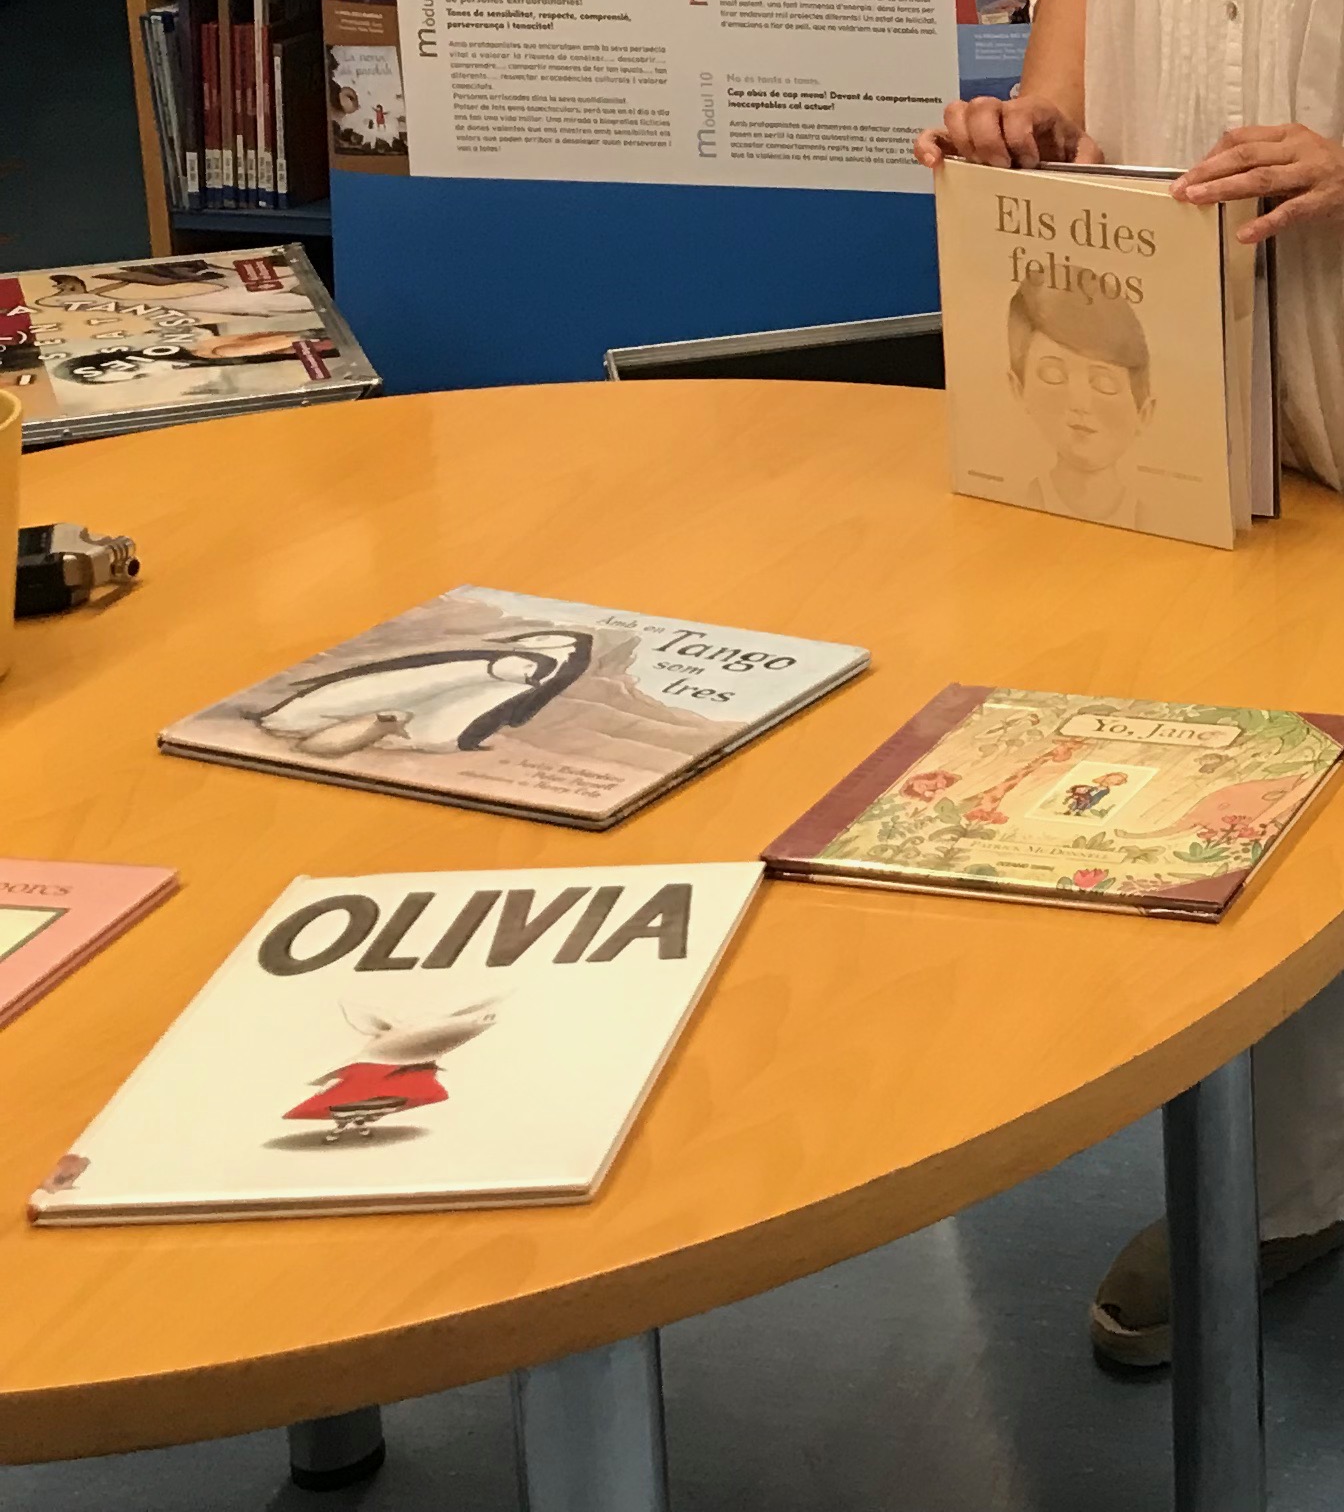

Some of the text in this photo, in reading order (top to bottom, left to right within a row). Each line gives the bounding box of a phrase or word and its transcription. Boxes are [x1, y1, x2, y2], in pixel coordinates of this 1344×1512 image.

[994, 194, 1158, 258] Els dies
[1008, 246, 1145, 306] feliços
[596, 615, 638, 629] Amb
[651, 629, 797, 672] Tango
[652, 660, 705, 675] som
[661, 678, 735, 703] tres
[1091, 718, 1225, 742] Yo, Jane
[257, 883, 693, 977] OLIVIA
